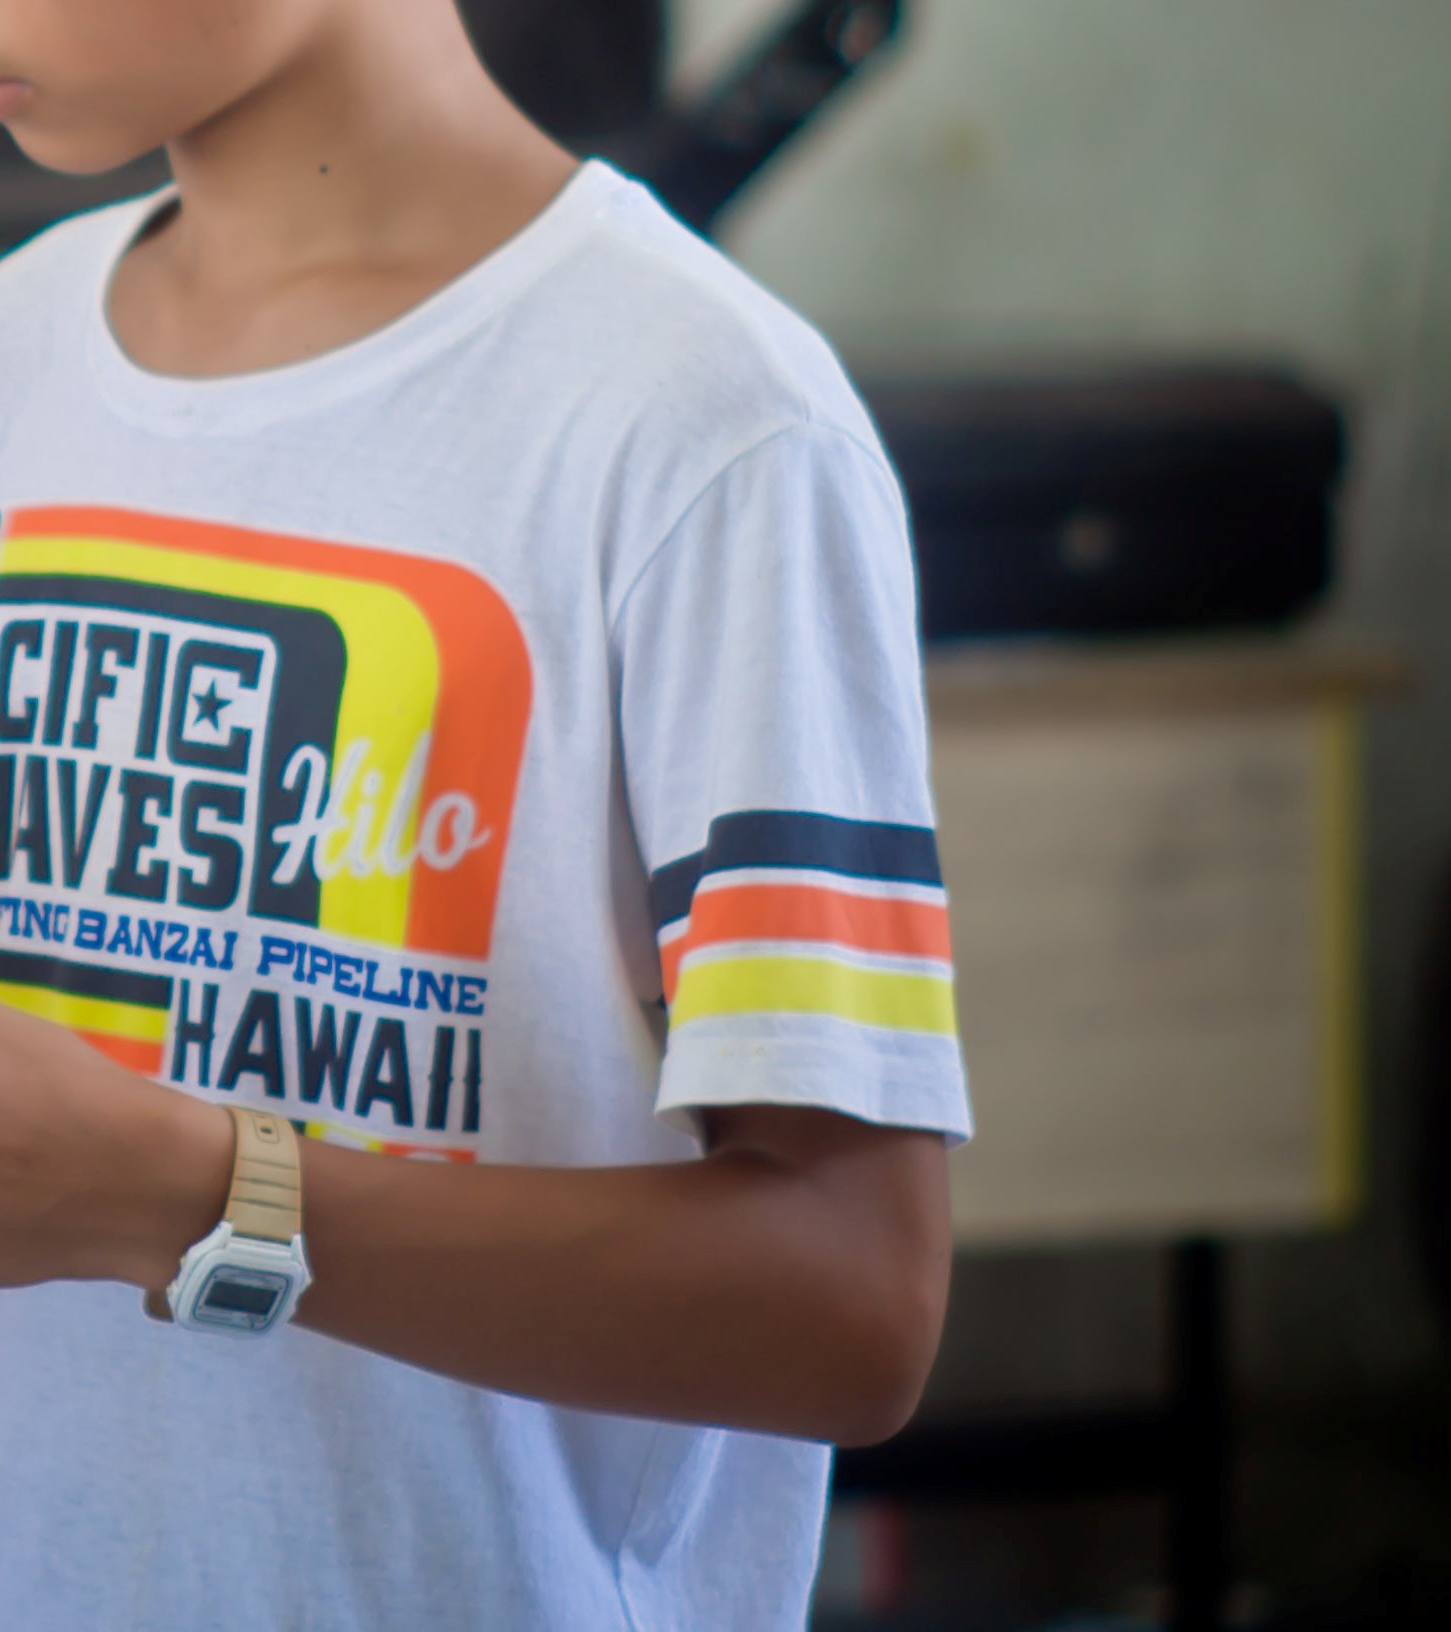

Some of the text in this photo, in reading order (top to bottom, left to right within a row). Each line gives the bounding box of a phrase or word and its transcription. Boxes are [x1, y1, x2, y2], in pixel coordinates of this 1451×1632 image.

[270, 728, 493, 885] Hilo
[73, 908, 239, 971] BANZAI
[256, 935, 488, 1016] PIPELINE
[170, 978, 482, 1134] HAWAII
